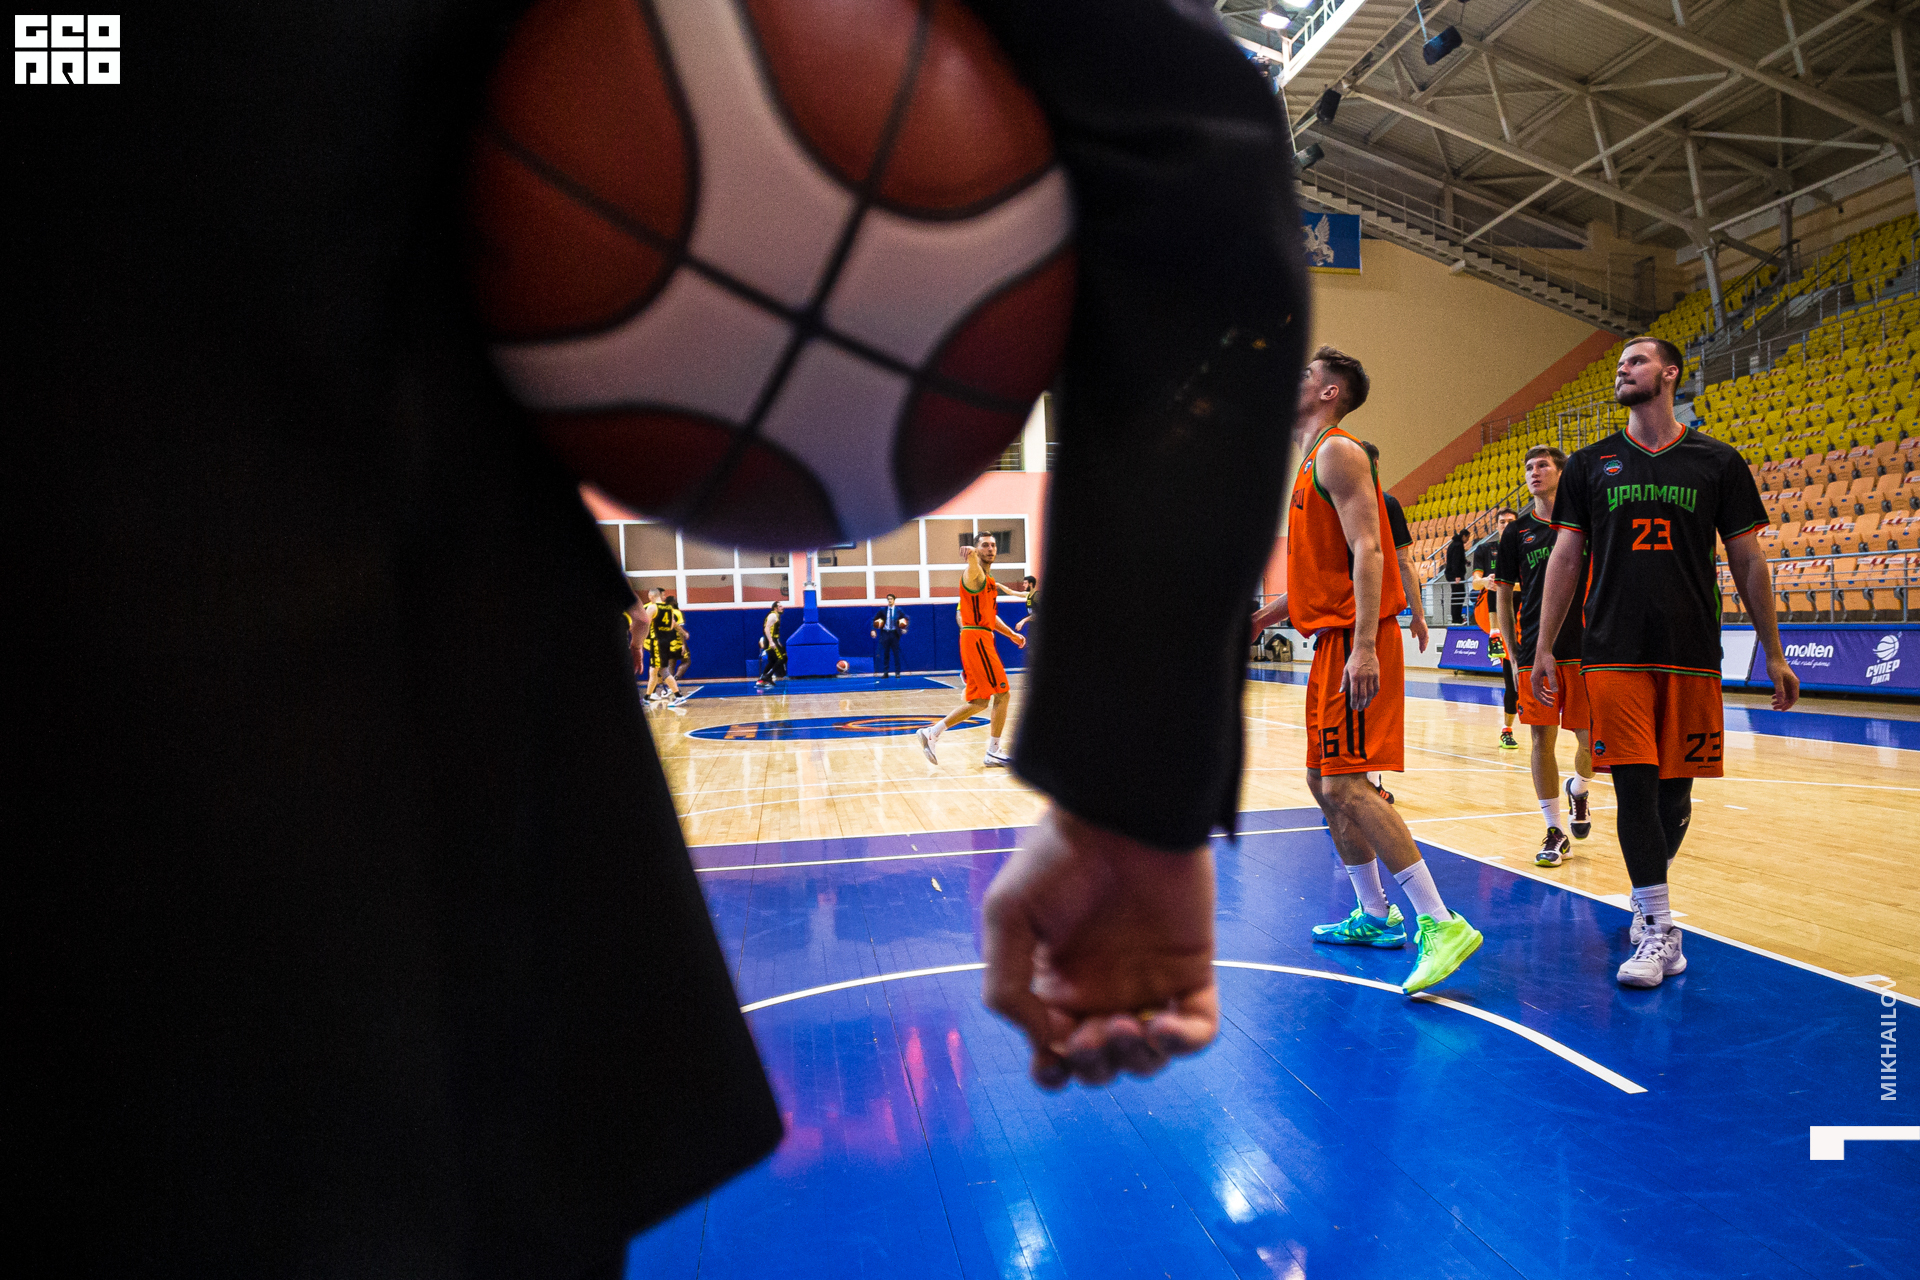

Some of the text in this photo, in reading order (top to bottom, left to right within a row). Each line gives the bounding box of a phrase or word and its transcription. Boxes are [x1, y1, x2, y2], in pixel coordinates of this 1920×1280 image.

[1606, 483, 1698, 513] УРАЛМАШ
[1631, 517, 1674, 551] 23
[661, 611, 670, 625] 4
[1456, 638, 1479, 649] molten
[1784, 642, 1834, 658] molten
[1865, 659, 1901, 678] СУПЕР
[1684, 730, 1722, 763] 23
